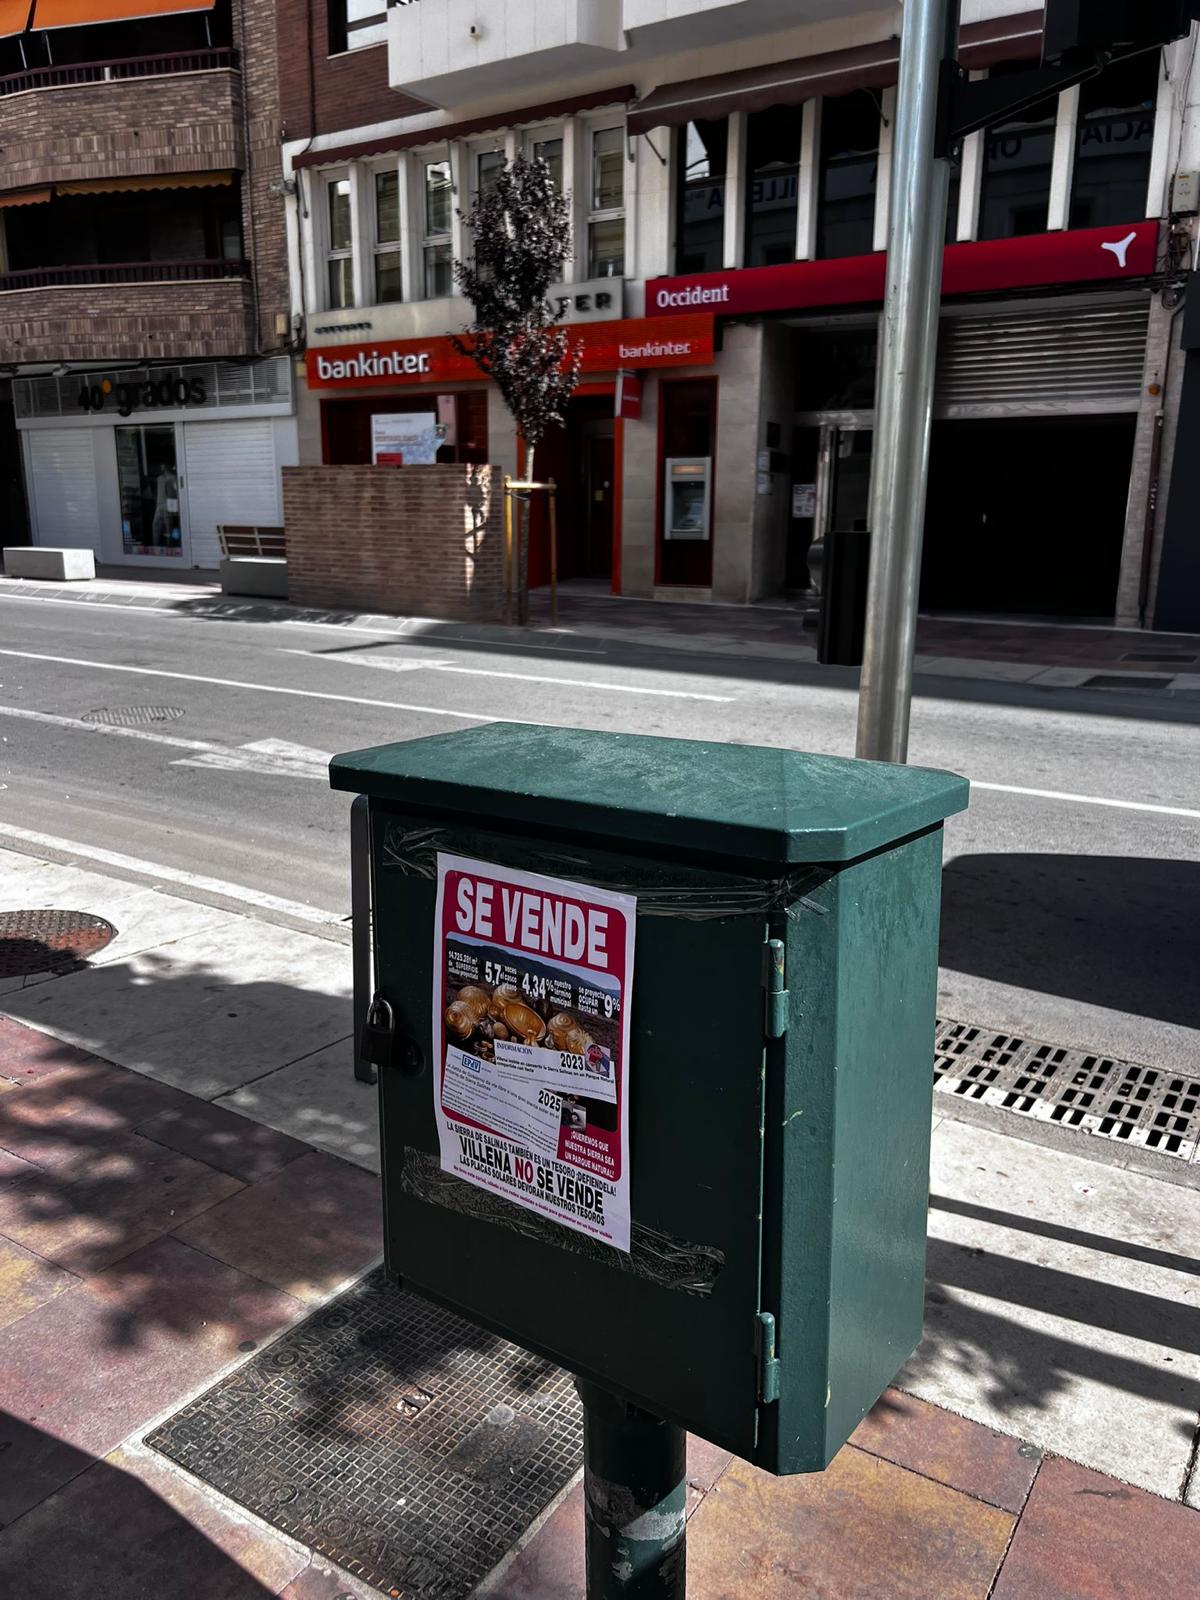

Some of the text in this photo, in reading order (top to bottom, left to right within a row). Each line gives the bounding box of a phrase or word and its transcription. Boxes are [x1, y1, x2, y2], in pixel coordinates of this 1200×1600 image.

[656, 284, 730, 308] Occident
[117, 375, 208, 417] grados
[455, 877, 608, 968] SE VENDE
[484, 960, 501, 985] 5,7
[578, 994, 599, 1008] OCUPAR
[578, 1003, 592, 1013] hasta
[560, 1053, 584, 1071] 2023
[537, 1089, 561, 1112] 2025
[446, 1121, 454, 1131] LA
[454, 1124, 474, 1139] SIERRA
[474, 1132, 483, 1143] DE
[483, 1134, 508, 1151] SALINAS
[533, 1154, 542, 1166] ES
[542, 1157, 551, 1168] UN
[551, 1160, 575, 1178] TESORO
[564, 1139, 615, 1167] NUESTRA SIERRA SEA
[598, 1140, 609, 1152] QUE
[564, 1151, 572, 1160] UN
[572, 1156, 592, 1169] PARQUE
[459, 1135, 604, 1214] VILLENA NO SE VENDE
[459, 1155, 605, 1226] LAS PLACAS SOLARES DEVORAN NUESTROS TESOROS
